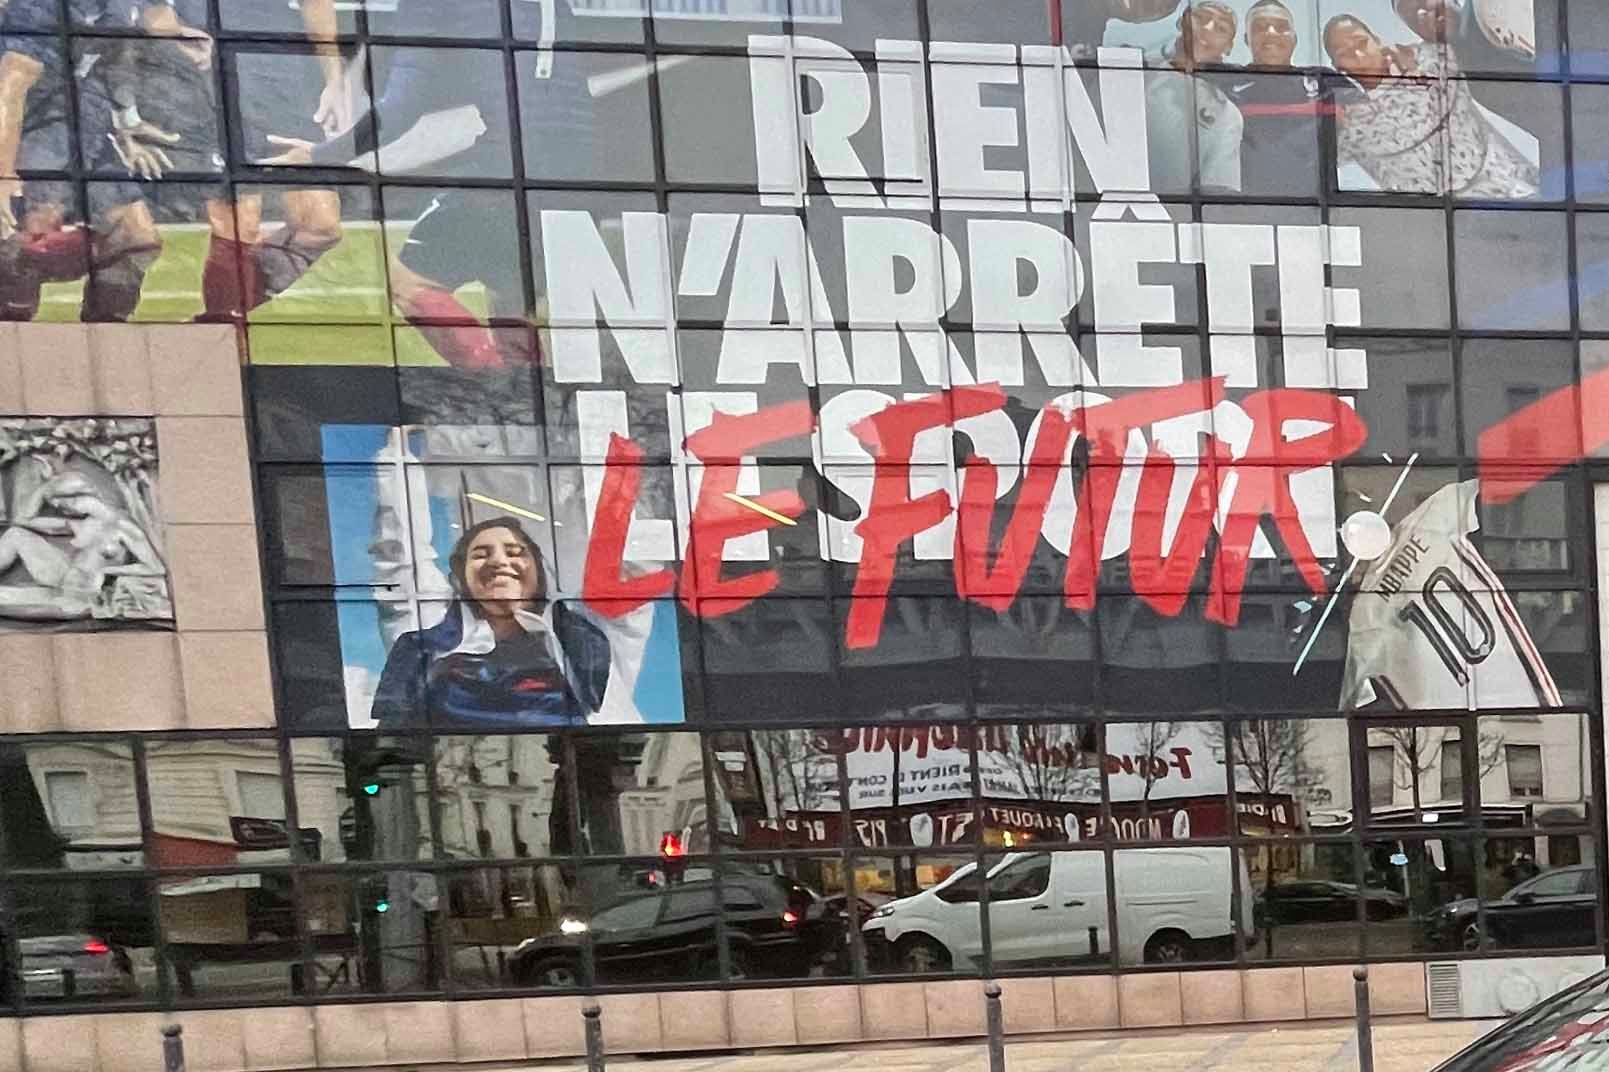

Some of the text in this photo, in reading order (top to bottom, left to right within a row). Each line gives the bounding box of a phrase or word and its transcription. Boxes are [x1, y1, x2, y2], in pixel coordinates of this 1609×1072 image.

[748, 35, 1151, 212] RIEN
[541, 192, 1369, 391] N'ARRÊTE
[582, 375, 1368, 650] LE FUTUR
[1399, 565, 1497, 688] 10
